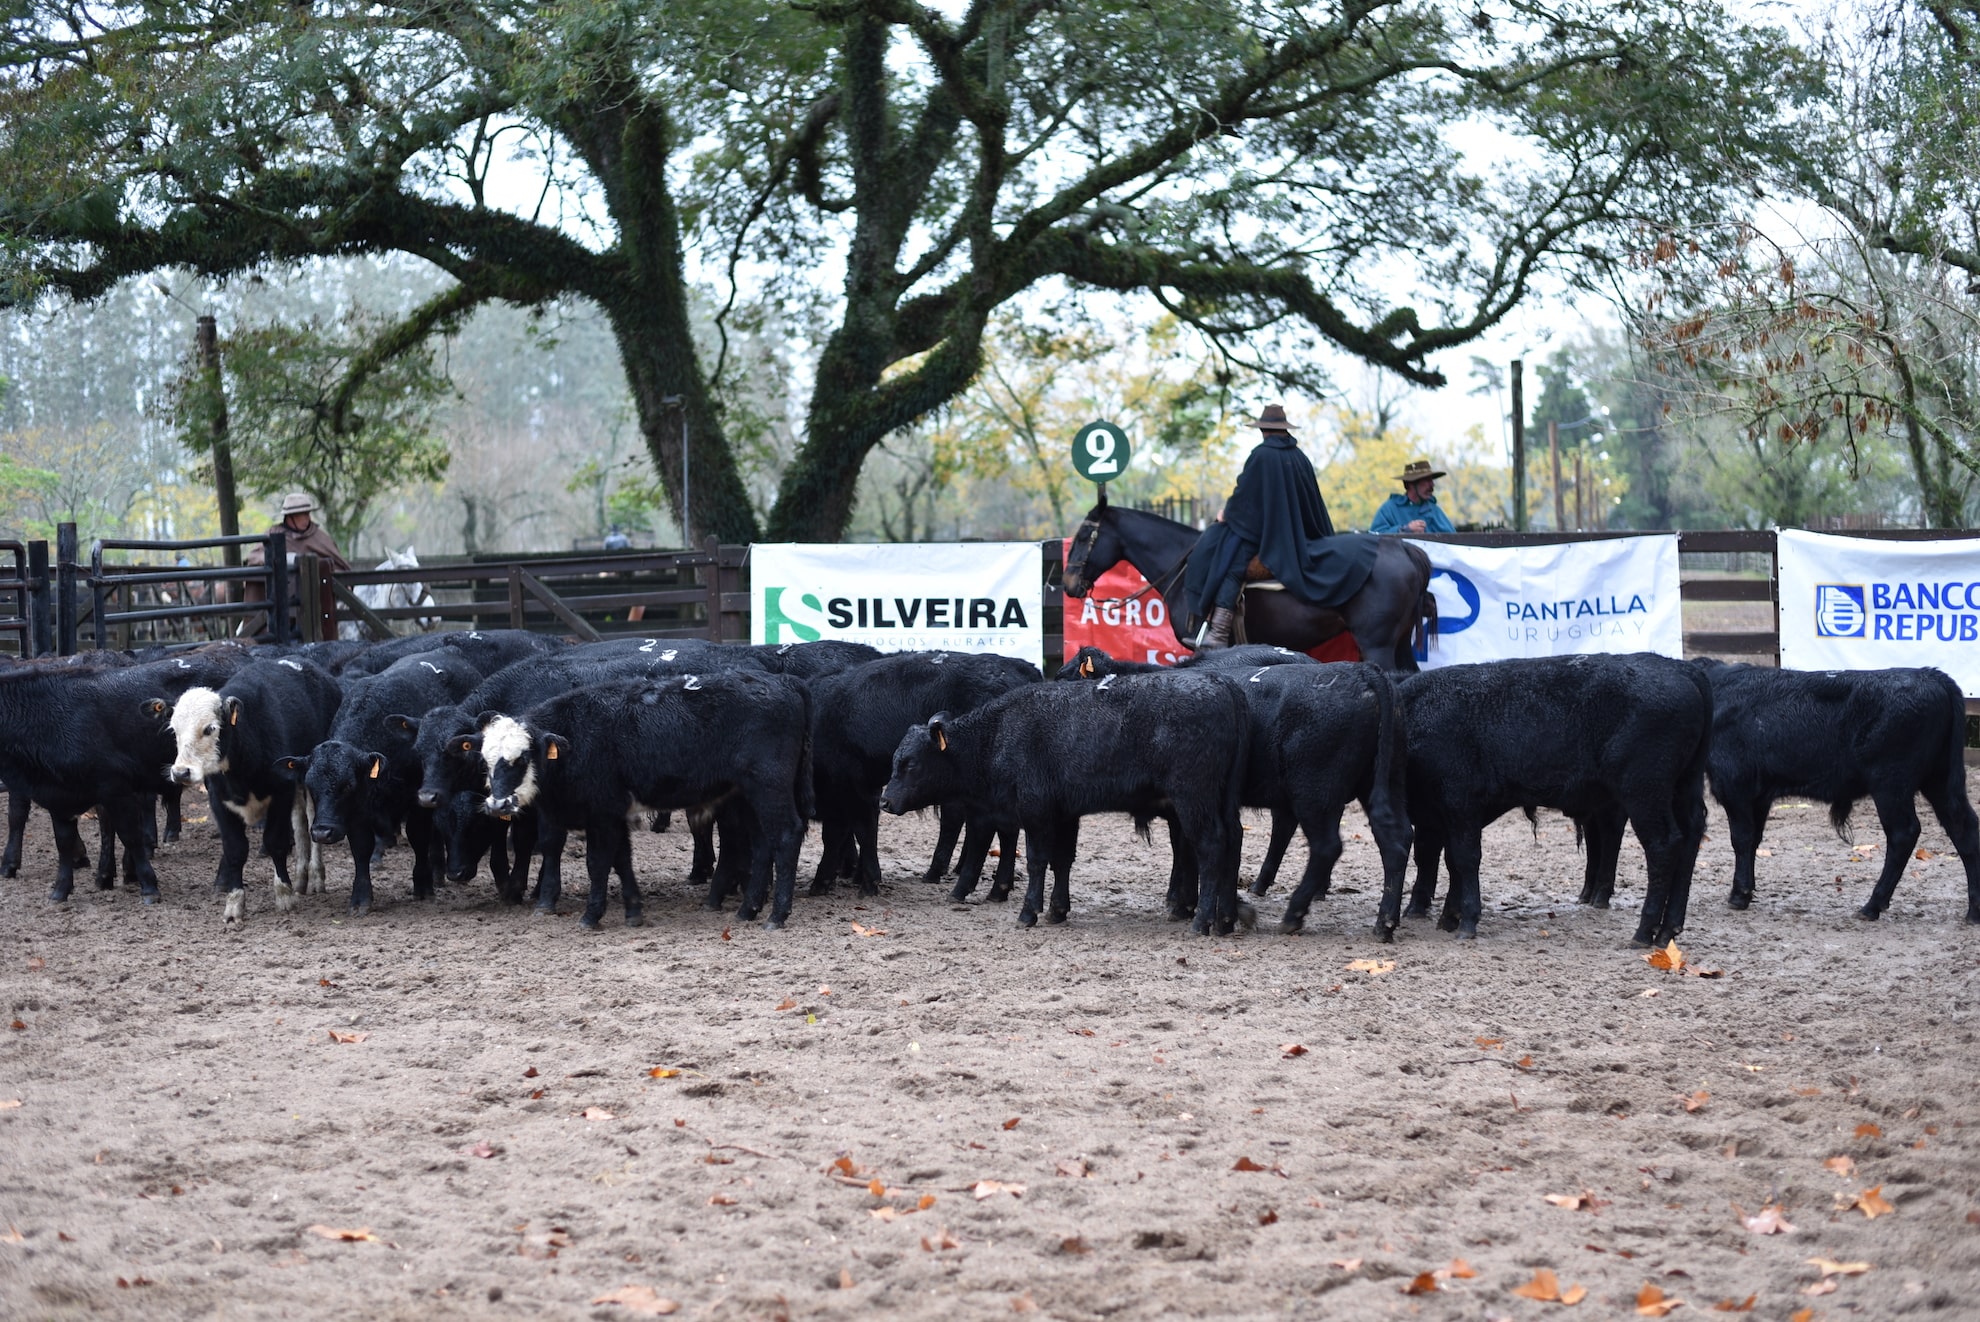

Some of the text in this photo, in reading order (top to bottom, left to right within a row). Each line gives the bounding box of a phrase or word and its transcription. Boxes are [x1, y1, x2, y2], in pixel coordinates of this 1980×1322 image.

[1085, 428, 1118, 475] 2
[1506, 594, 1647, 621] PANTALLA
[1872, 582, 1980, 610] BANCO
[827, 597, 1028, 629] SILVEIRA
[1080, 597, 1165, 626] AGRO
[1507, 620, 1645, 642] URUGUAY
[1874, 613, 1979, 641] REPUB
[639, 639, 658, 652] 2
[943, 637, 1016, 646] RURALES
[683, 673, 702, 690] 2
